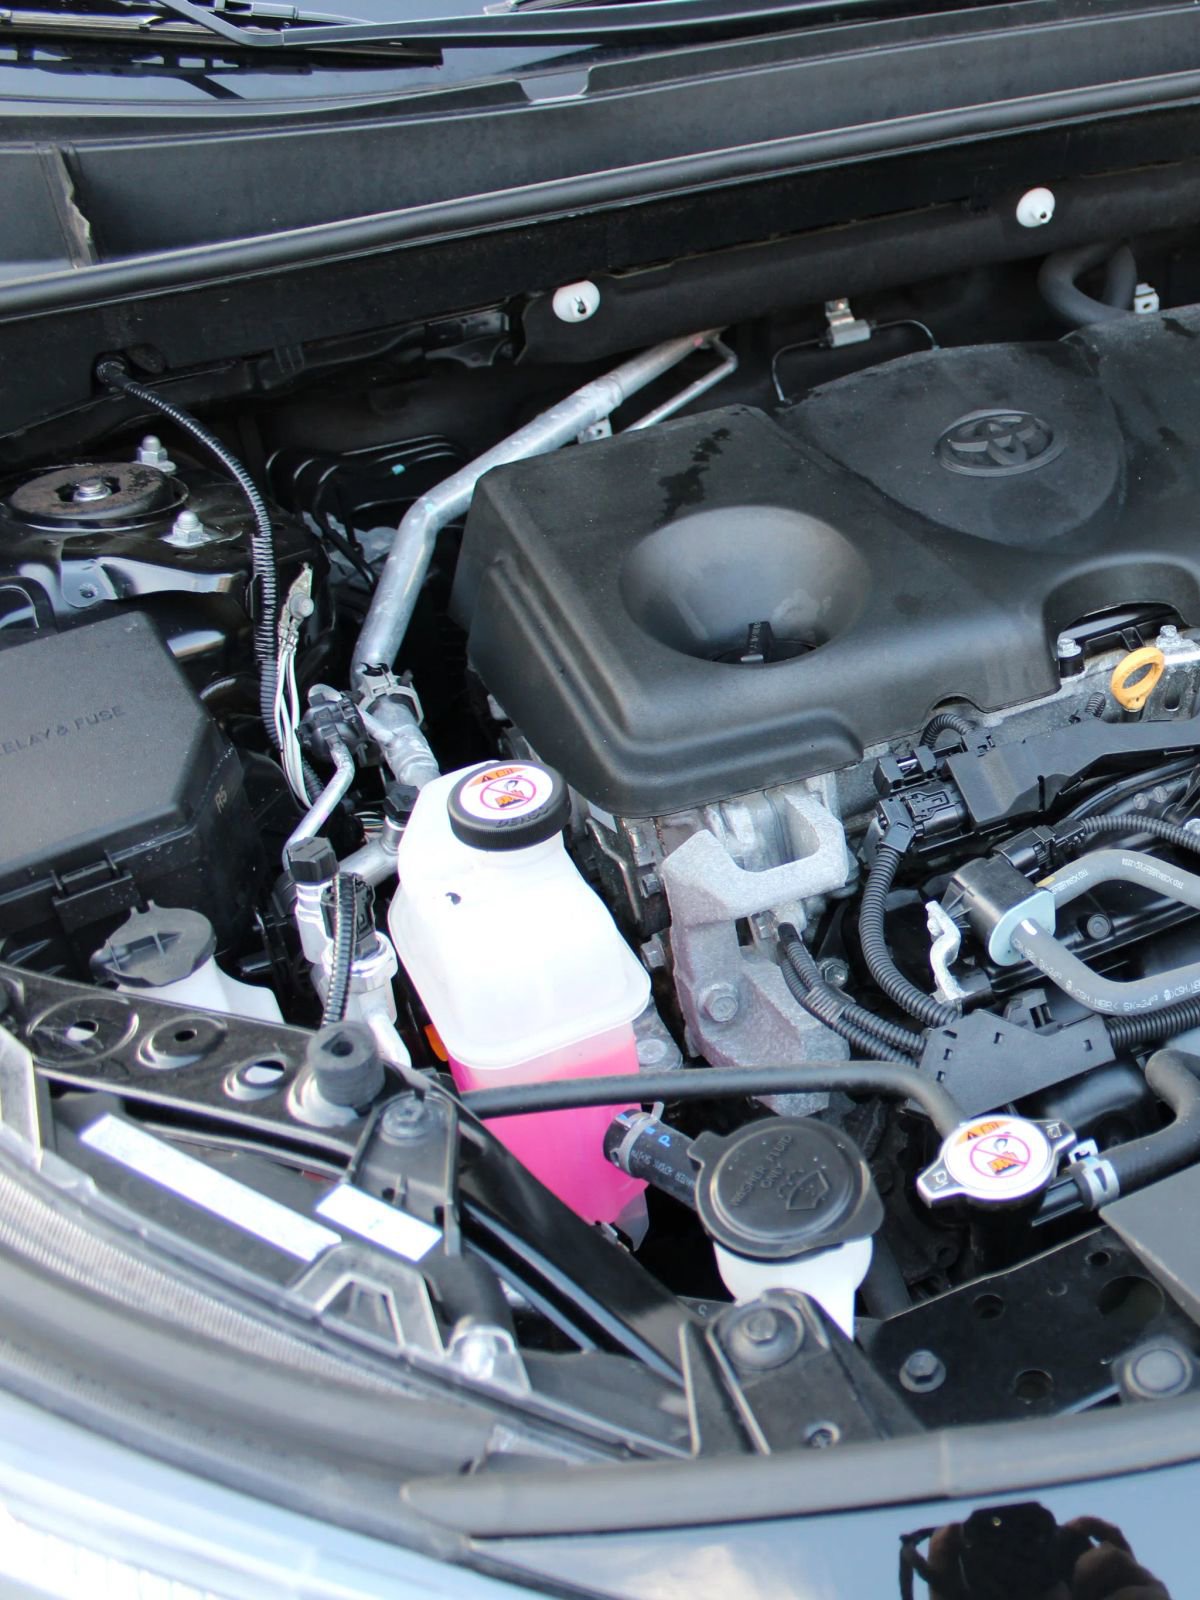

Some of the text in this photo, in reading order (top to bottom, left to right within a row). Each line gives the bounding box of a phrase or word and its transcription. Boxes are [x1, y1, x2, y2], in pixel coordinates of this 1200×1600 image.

[0, 728, 50, 756] ELAY
[74, 705, 126, 731] FUSE
[214, 783, 227, 814] R5
[731, 1134, 793, 1206] WASHER FLUID
[760, 1162, 785, 1189] ONLY
